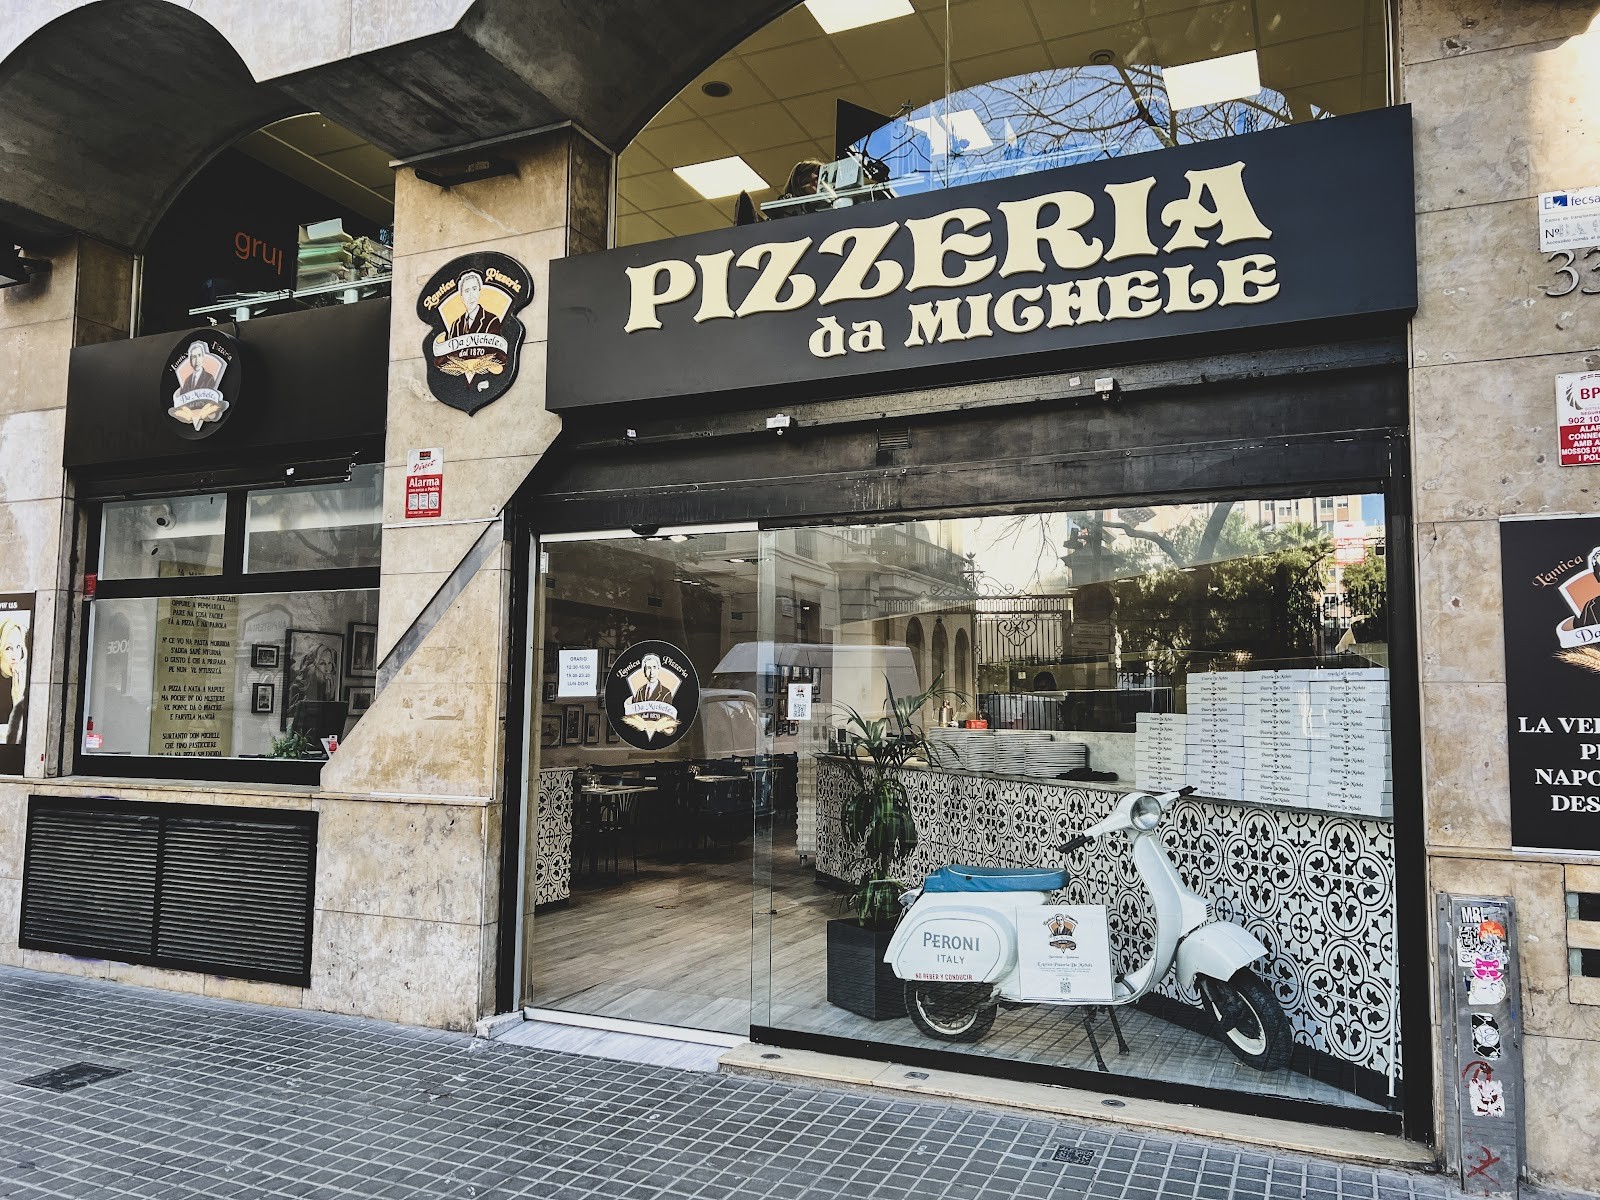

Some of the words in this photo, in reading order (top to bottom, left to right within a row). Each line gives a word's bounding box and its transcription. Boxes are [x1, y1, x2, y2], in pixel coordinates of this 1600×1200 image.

[623, 160, 1273, 334] PIZZERIA
[485, 268, 522, 293] Pizzeria
[808, 316, 886, 359] da
[904, 254, 1282, 348] MICHELE
[448, 339, 464, 350] Da
[466, 335, 500, 346] Michele
[470, 348, 485, 356] 1870
[1562, 447, 1590, 455] MOSSOS
[409, 477, 440, 487] Alarma
[662, 656, 689, 678] Pizzeria
[646, 703, 671, 712] Michele
[1518, 716, 1553, 733] LA
[1550, 795, 1600, 812] DES
[923, 932, 980, 952] PERONI
[937, 954, 964, 964] ITALY
